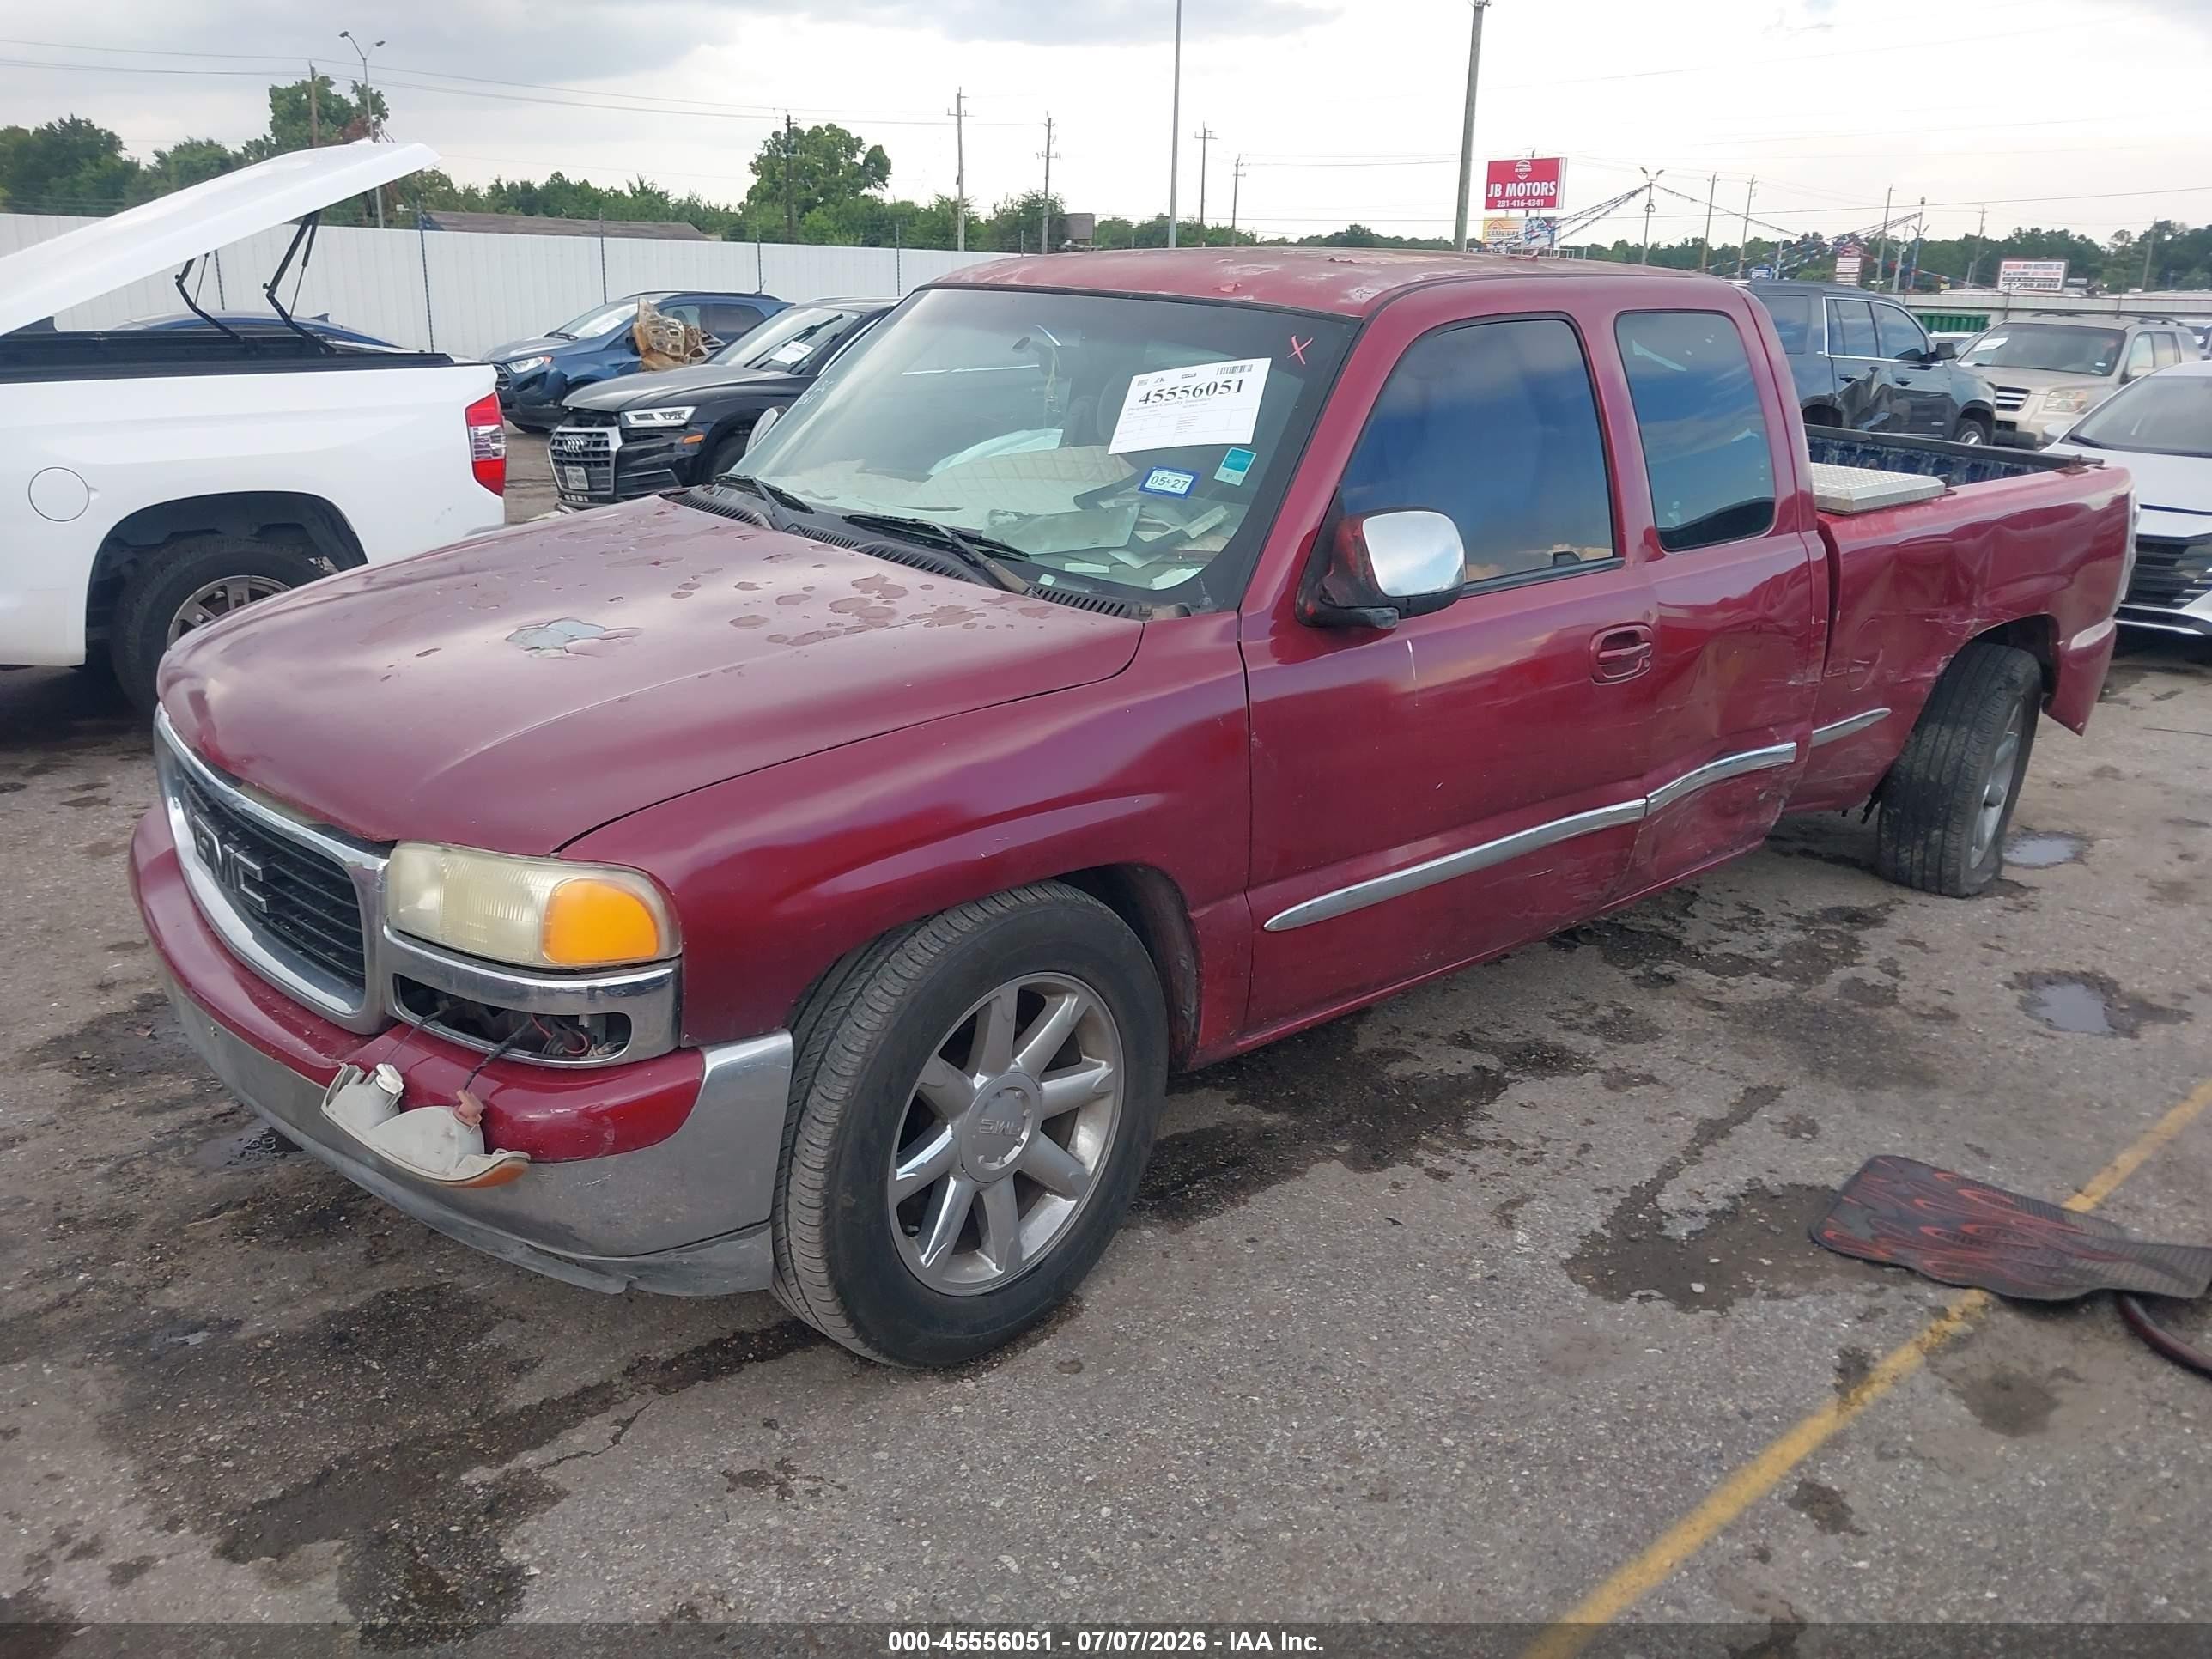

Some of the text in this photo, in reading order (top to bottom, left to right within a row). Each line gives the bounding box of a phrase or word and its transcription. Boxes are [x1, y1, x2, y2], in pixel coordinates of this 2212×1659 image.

[1487, 181, 1556, 198] JB MOTORS
[1497, 198, 1544, 208] 281-416-4341
[1138, 378, 1244, 404] 45556051
[1150, 475, 1188, 489] 05 27
